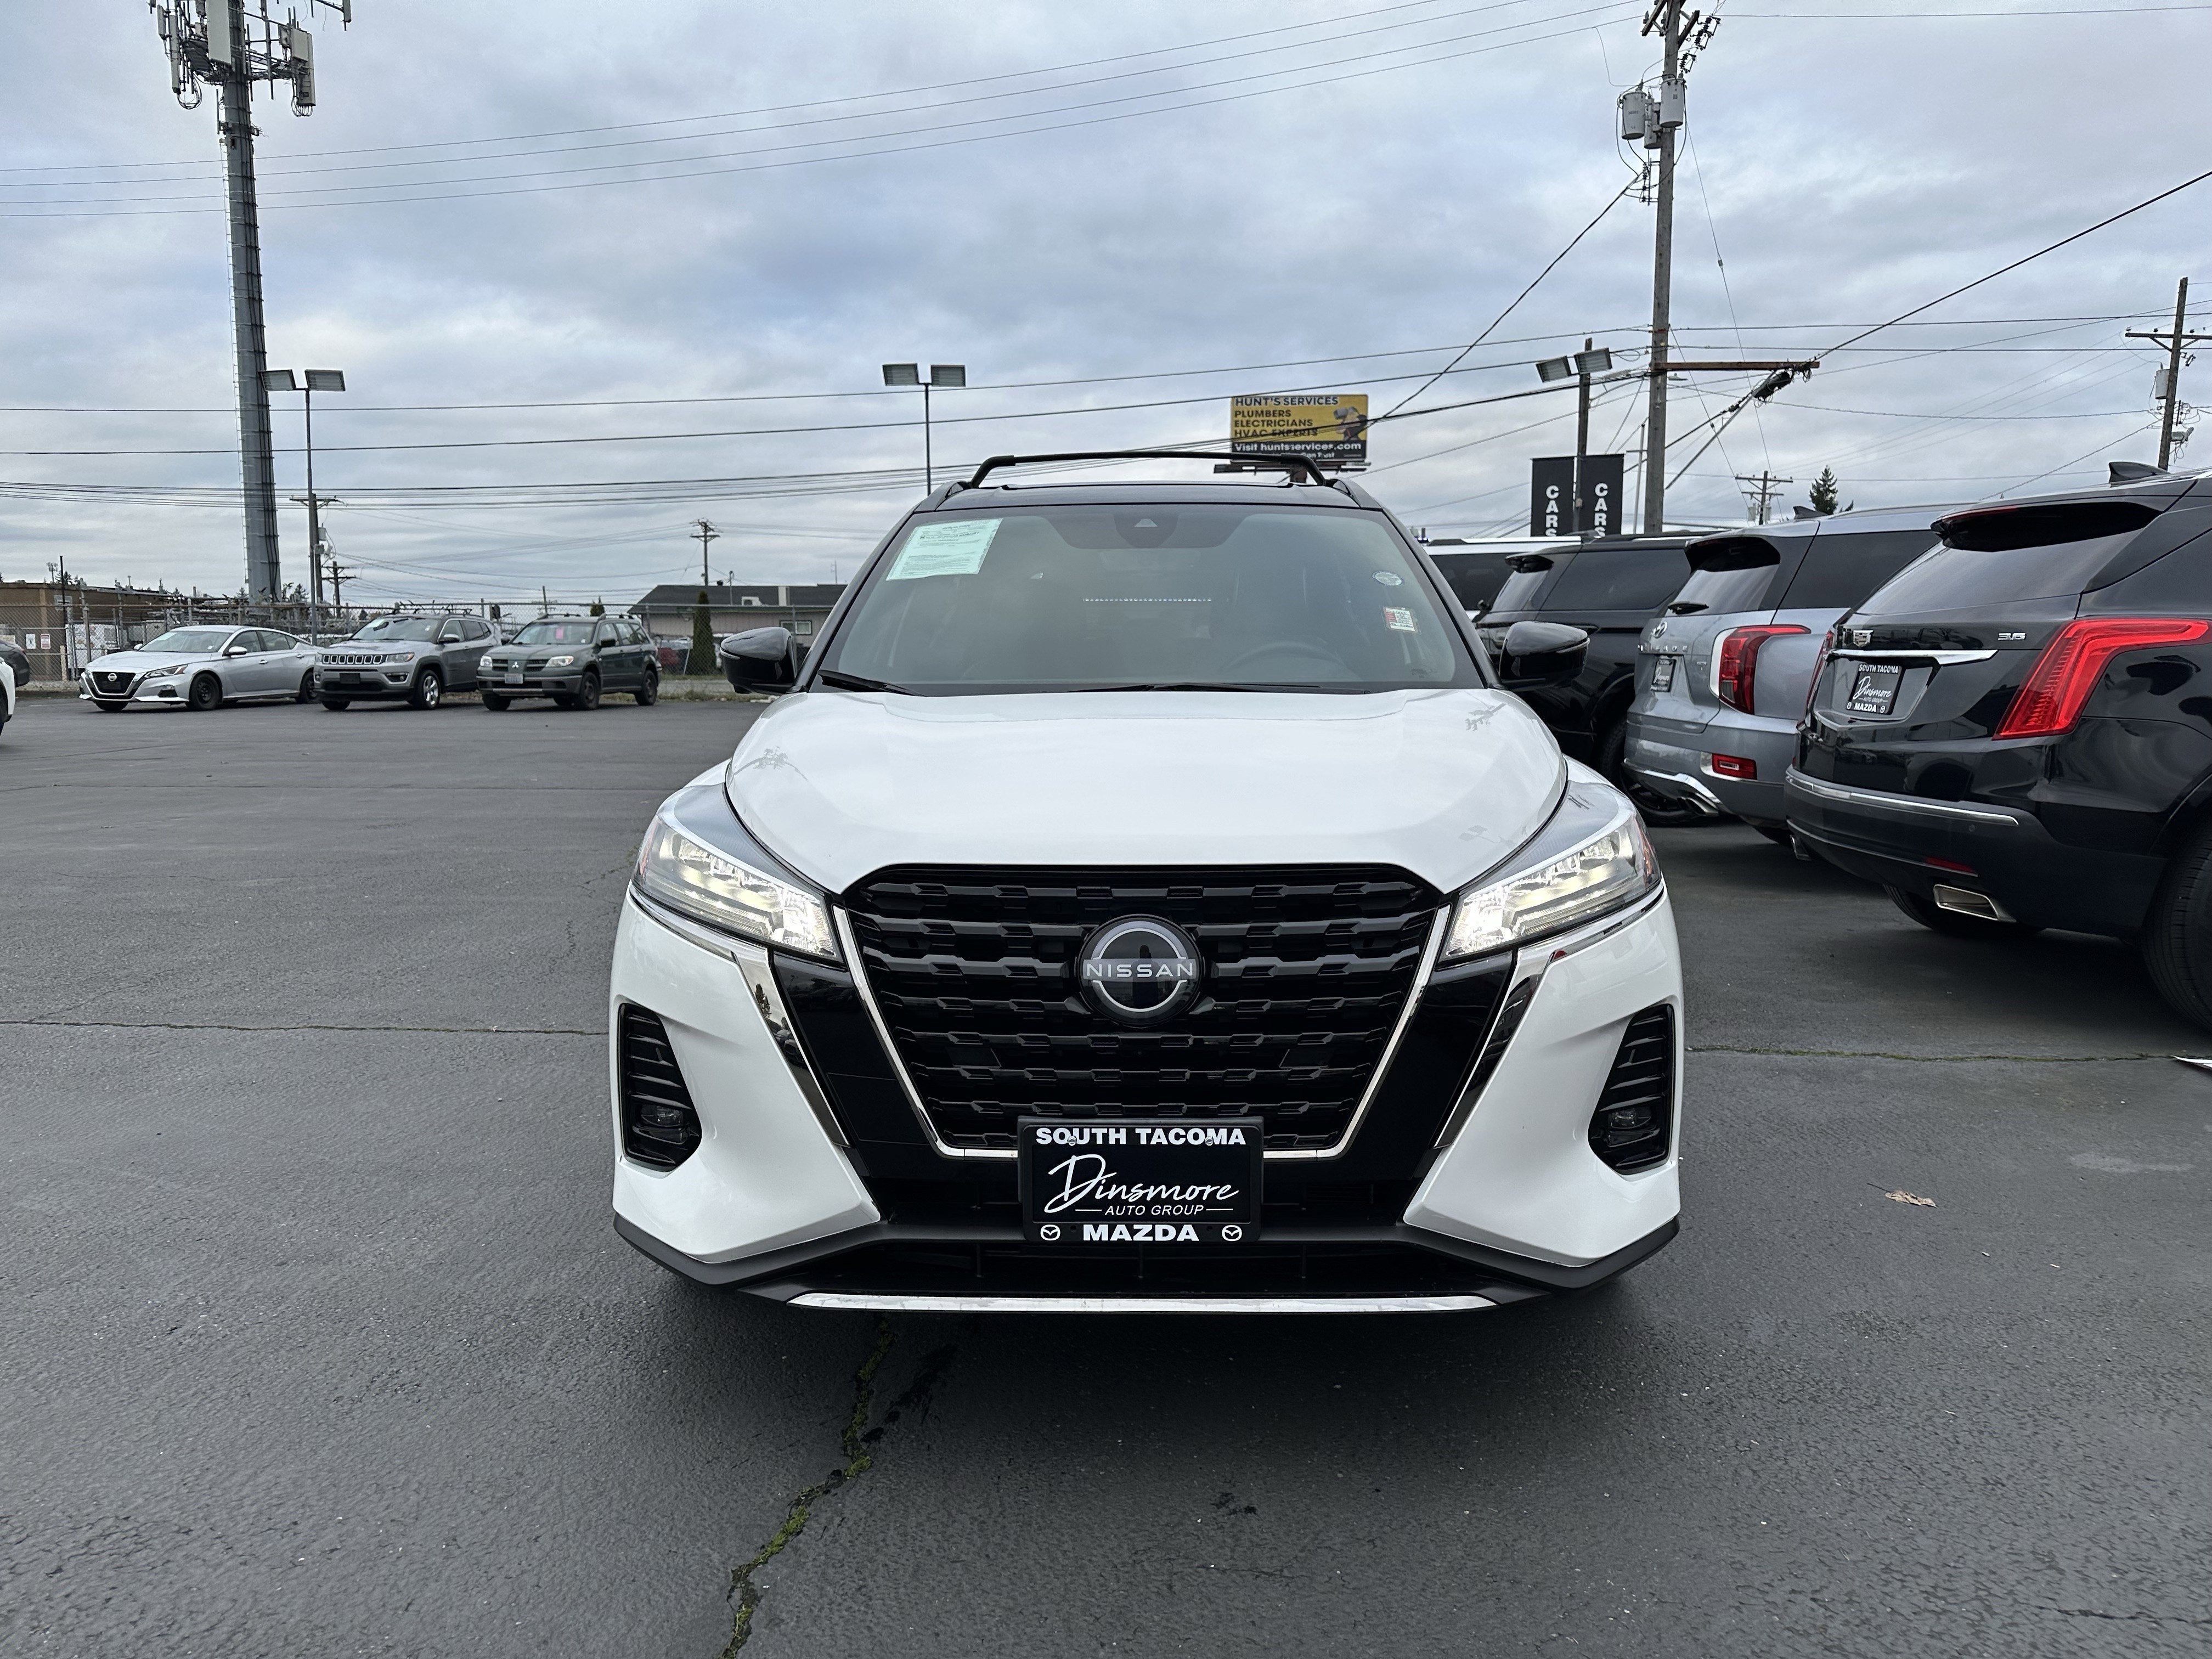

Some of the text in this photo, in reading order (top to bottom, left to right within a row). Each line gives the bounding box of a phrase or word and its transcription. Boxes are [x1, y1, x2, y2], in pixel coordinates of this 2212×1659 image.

[1235, 396, 1339, 406] HUNT'S SERVICES
[1234, 409, 1291, 417] PLUMBERS
[1234, 419, 1313, 427] ELECTRICIANS
[1234, 429, 1268, 438] HVAC
[1235, 443, 1258, 451] Visit
[1545, 486, 1559, 537] CARS
[1594, 483, 1608, 537] CARS
[1997, 633, 2026, 641] 3.6
[1858, 664, 1898, 674] SOUTH TACOMA
[1852, 675, 1892, 700] Dinsmore
[1854, 702, 1877, 713] MAZDA
[1086, 963, 1193, 978] NISSAN
[1036, 1127, 1246, 1145] SOUTH TACOMA
[1043, 1154, 1239, 1214] Dinsmore
[1104, 1205, 1204, 1216] AUTO GROUP
[1083, 1224, 1199, 1241] MAZDA
